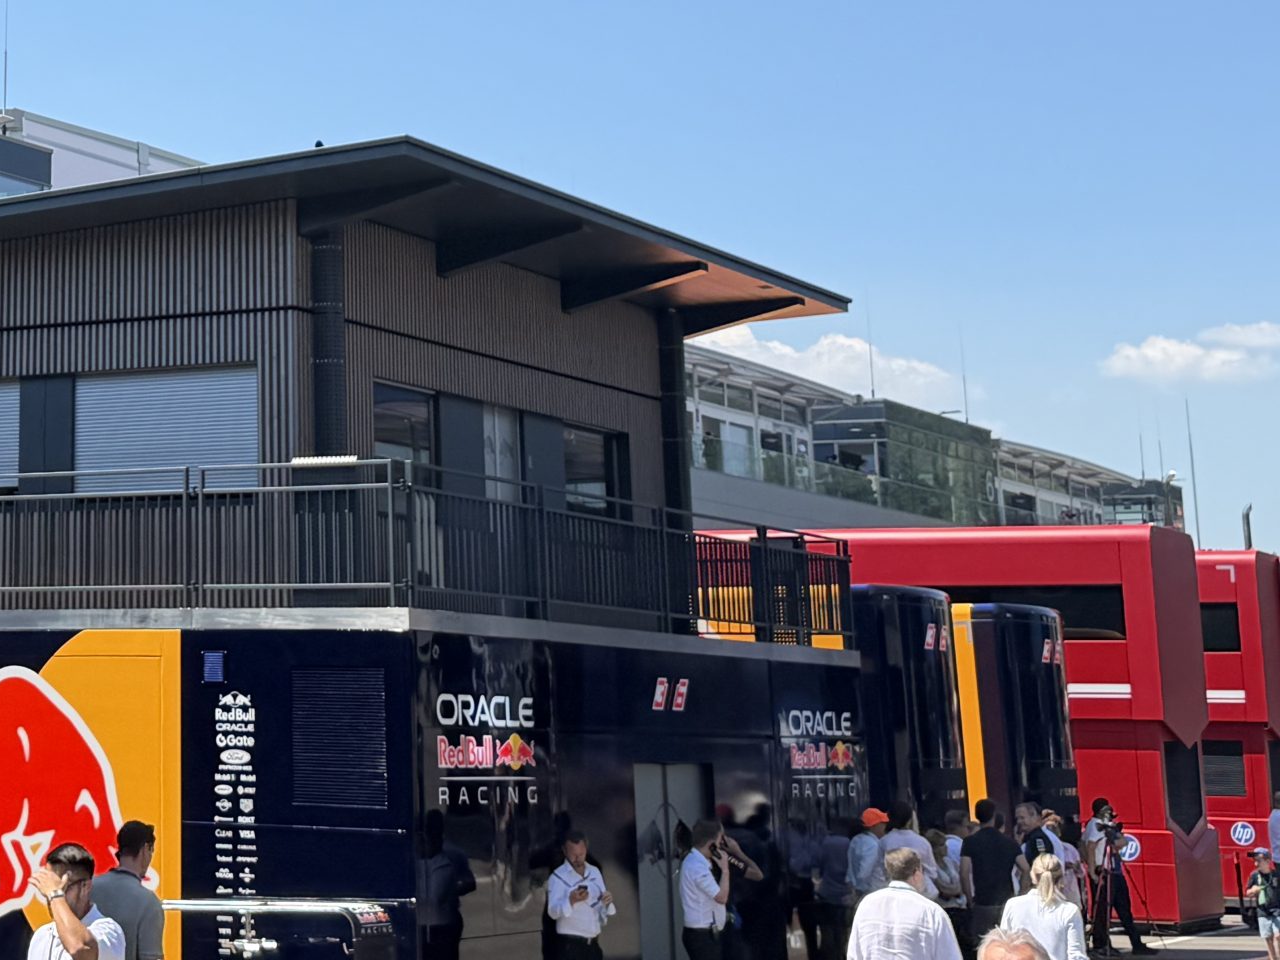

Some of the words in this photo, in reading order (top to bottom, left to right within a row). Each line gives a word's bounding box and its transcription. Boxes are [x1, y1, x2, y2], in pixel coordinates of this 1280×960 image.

[215, 707, 235, 721] Red
[236, 708, 256, 722] Bull
[437, 693, 535, 728] ORACLE
[215, 722, 255, 732] ORACLE
[788, 710, 851, 736] ORACLE
[437, 734, 465, 768] Red
[465, 734, 493, 769] Bull
[438, 786, 538, 805] RACING
[792, 783, 856, 798] RACING
[1234, 824, 1252, 845] hp
